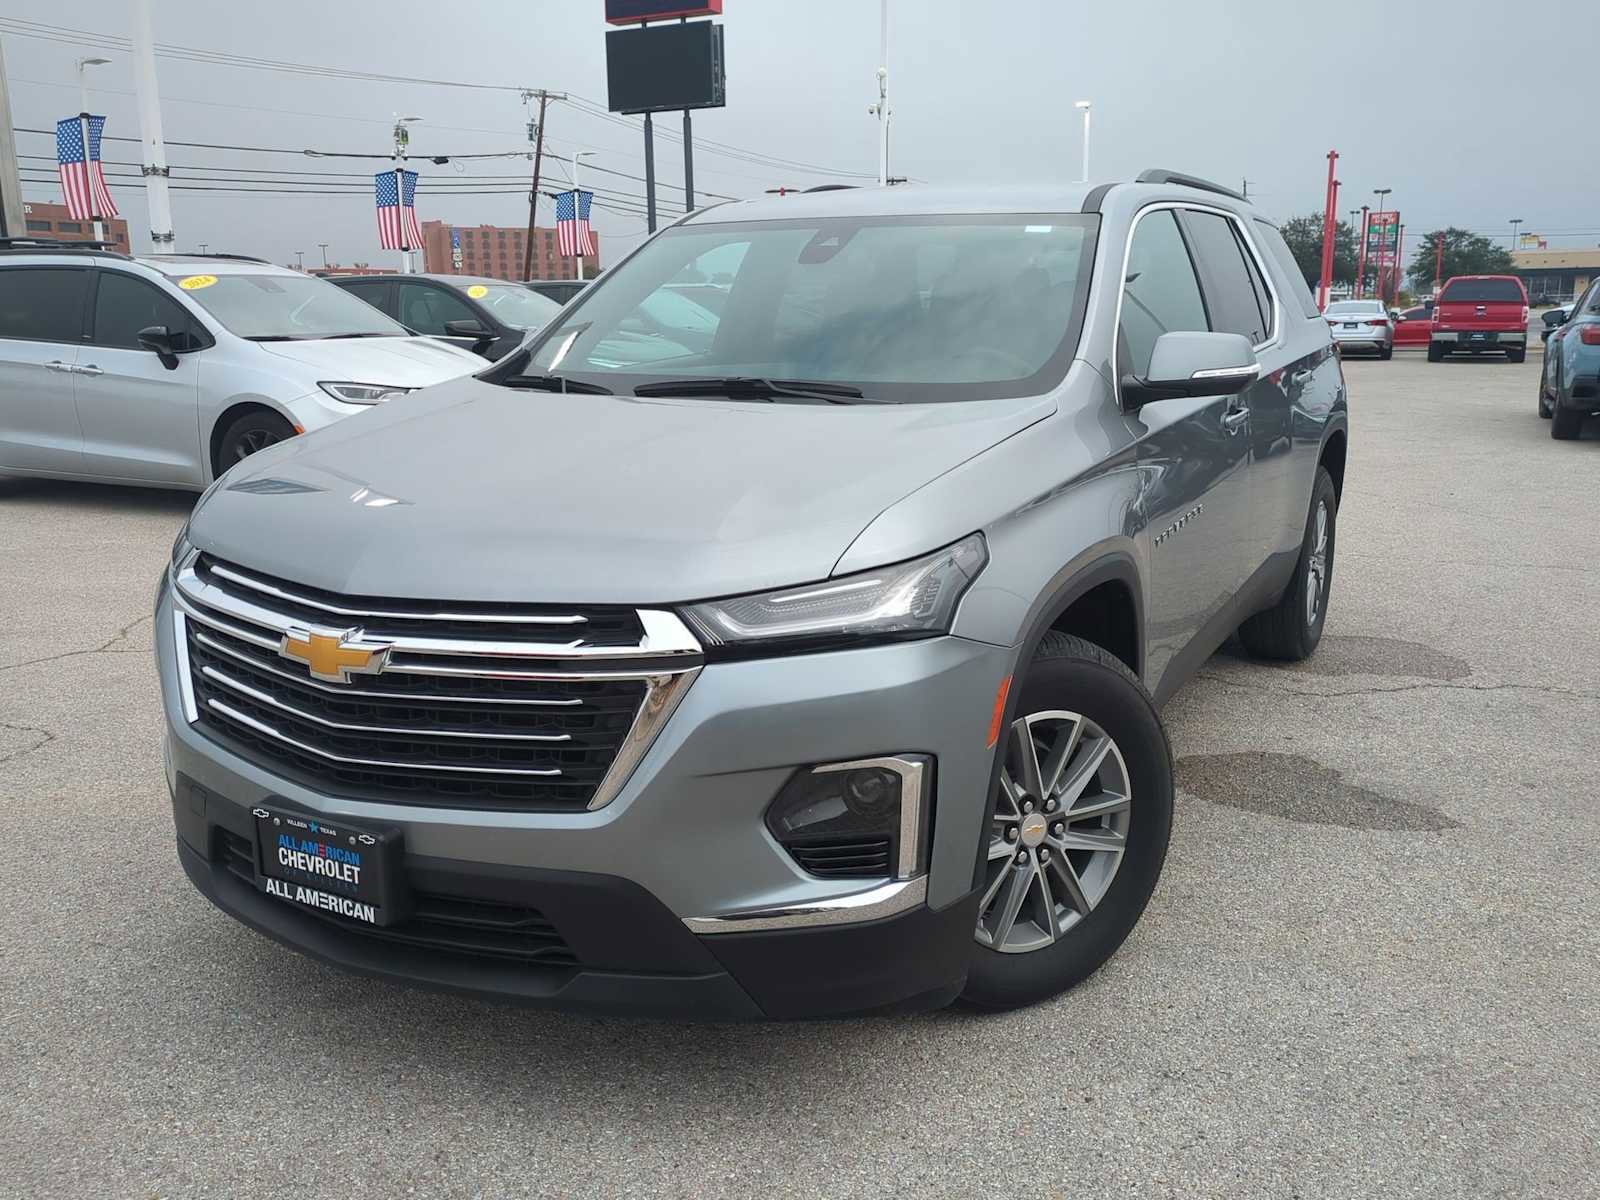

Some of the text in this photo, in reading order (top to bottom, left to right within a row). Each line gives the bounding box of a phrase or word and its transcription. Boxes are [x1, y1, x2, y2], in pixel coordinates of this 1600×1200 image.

[320, 827, 337, 836] TEXAS
[278, 833, 361, 865] ALL AMERICAN
[278, 847, 361, 884] CHEVROLET
[266, 878, 376, 924] ALL AMERICAN
